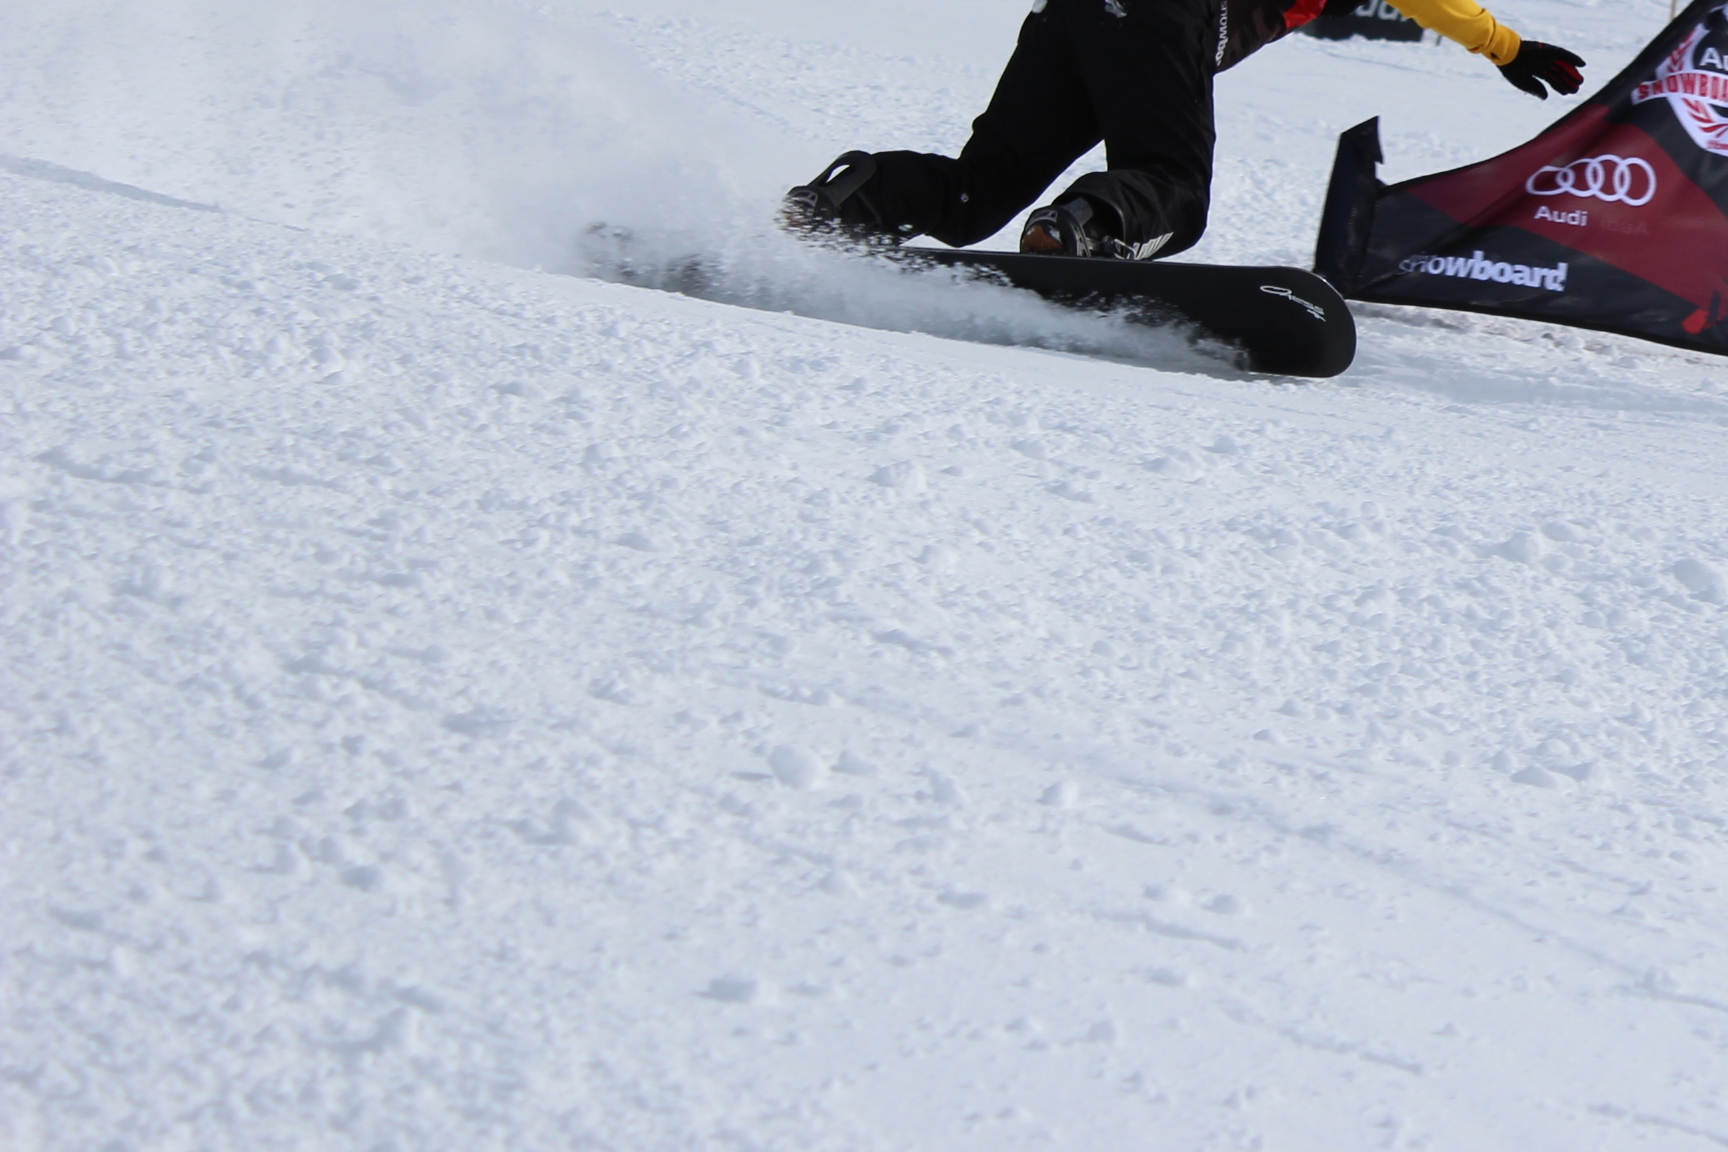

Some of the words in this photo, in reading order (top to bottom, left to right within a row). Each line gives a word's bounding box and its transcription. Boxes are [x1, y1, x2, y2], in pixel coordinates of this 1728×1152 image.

[1215, 0, 1228, 66] snowbo
[1533, 205, 1589, 226] Audi
[1396, 250, 1569, 292] snowboard
